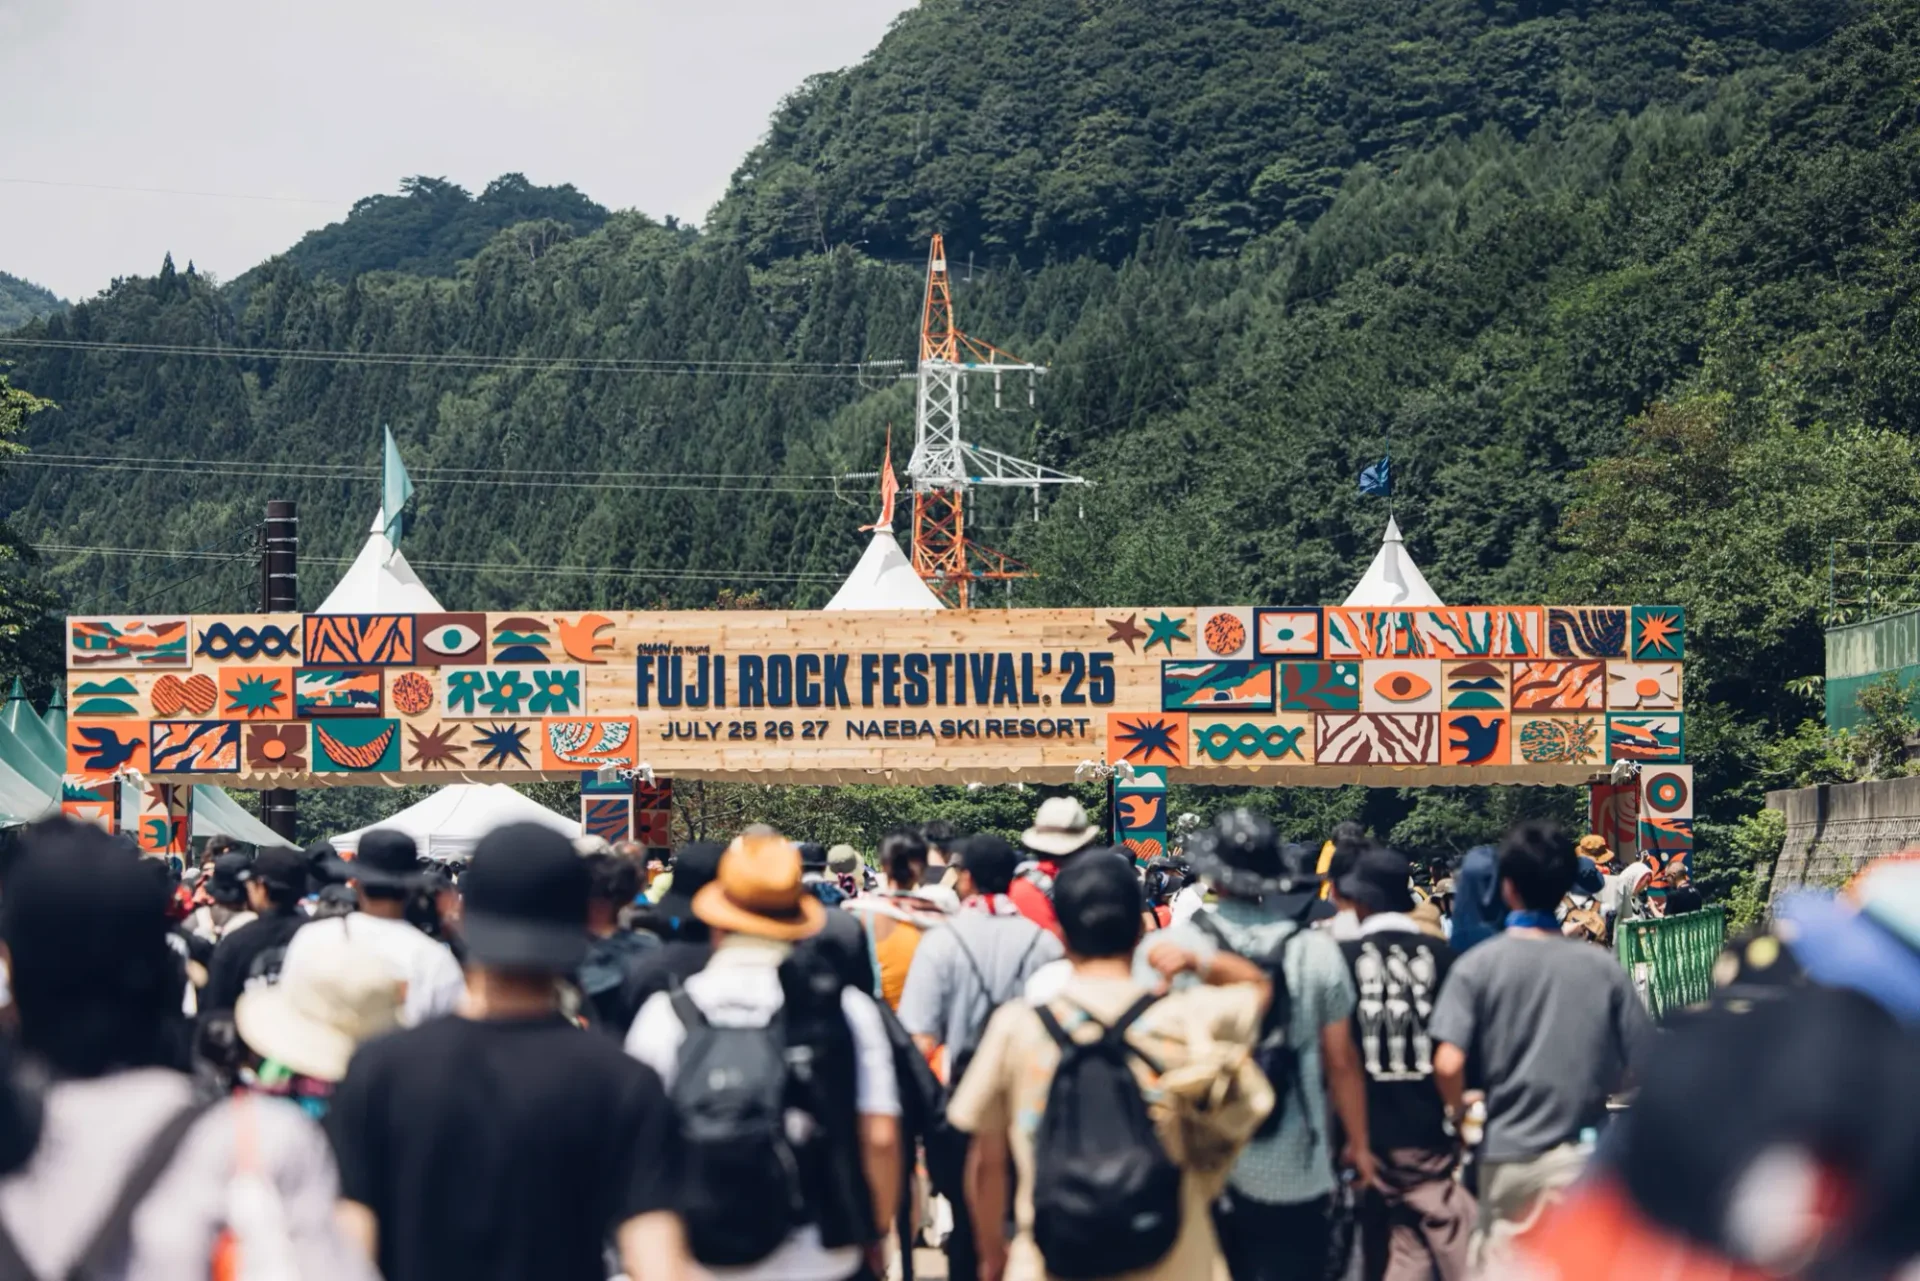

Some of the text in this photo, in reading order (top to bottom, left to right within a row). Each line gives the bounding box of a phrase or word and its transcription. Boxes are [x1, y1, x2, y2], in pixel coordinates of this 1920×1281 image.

[637, 655, 726, 707] FUJI
[739, 654, 851, 707] ROCK
[661, 718, 1090, 740] JULY 25 26 27 NAEBA SKI RESORT
